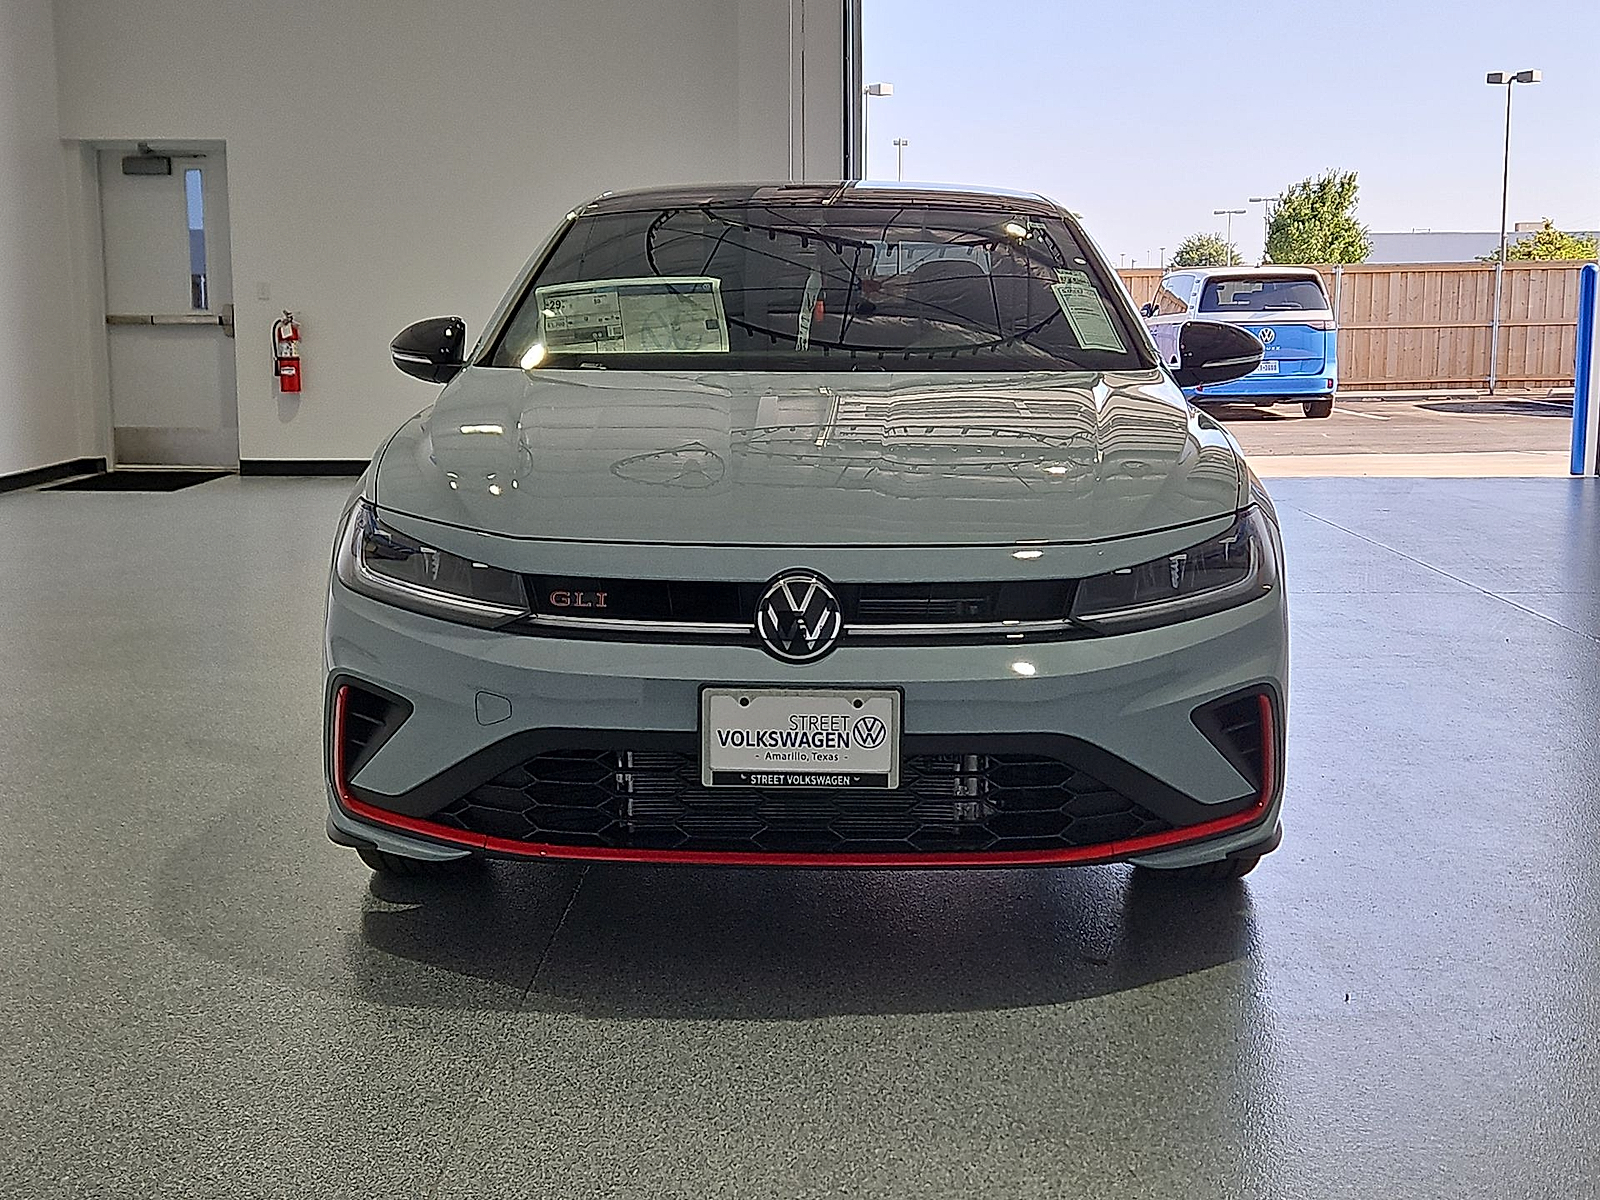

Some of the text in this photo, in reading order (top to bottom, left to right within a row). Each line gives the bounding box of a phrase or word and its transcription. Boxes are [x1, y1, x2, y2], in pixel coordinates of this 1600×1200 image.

[550, 591, 607, 608] GLI
[756, 571, 842, 661] VW
[789, 715, 850, 731] STREET
[717, 730, 850, 748] VOLKSWAGEN
[853, 716, 886, 749] VW
[764, 752, 839, 762] Amarillo, Texas
[751, 775, 850, 786] STREET VOLKSWAGEN
